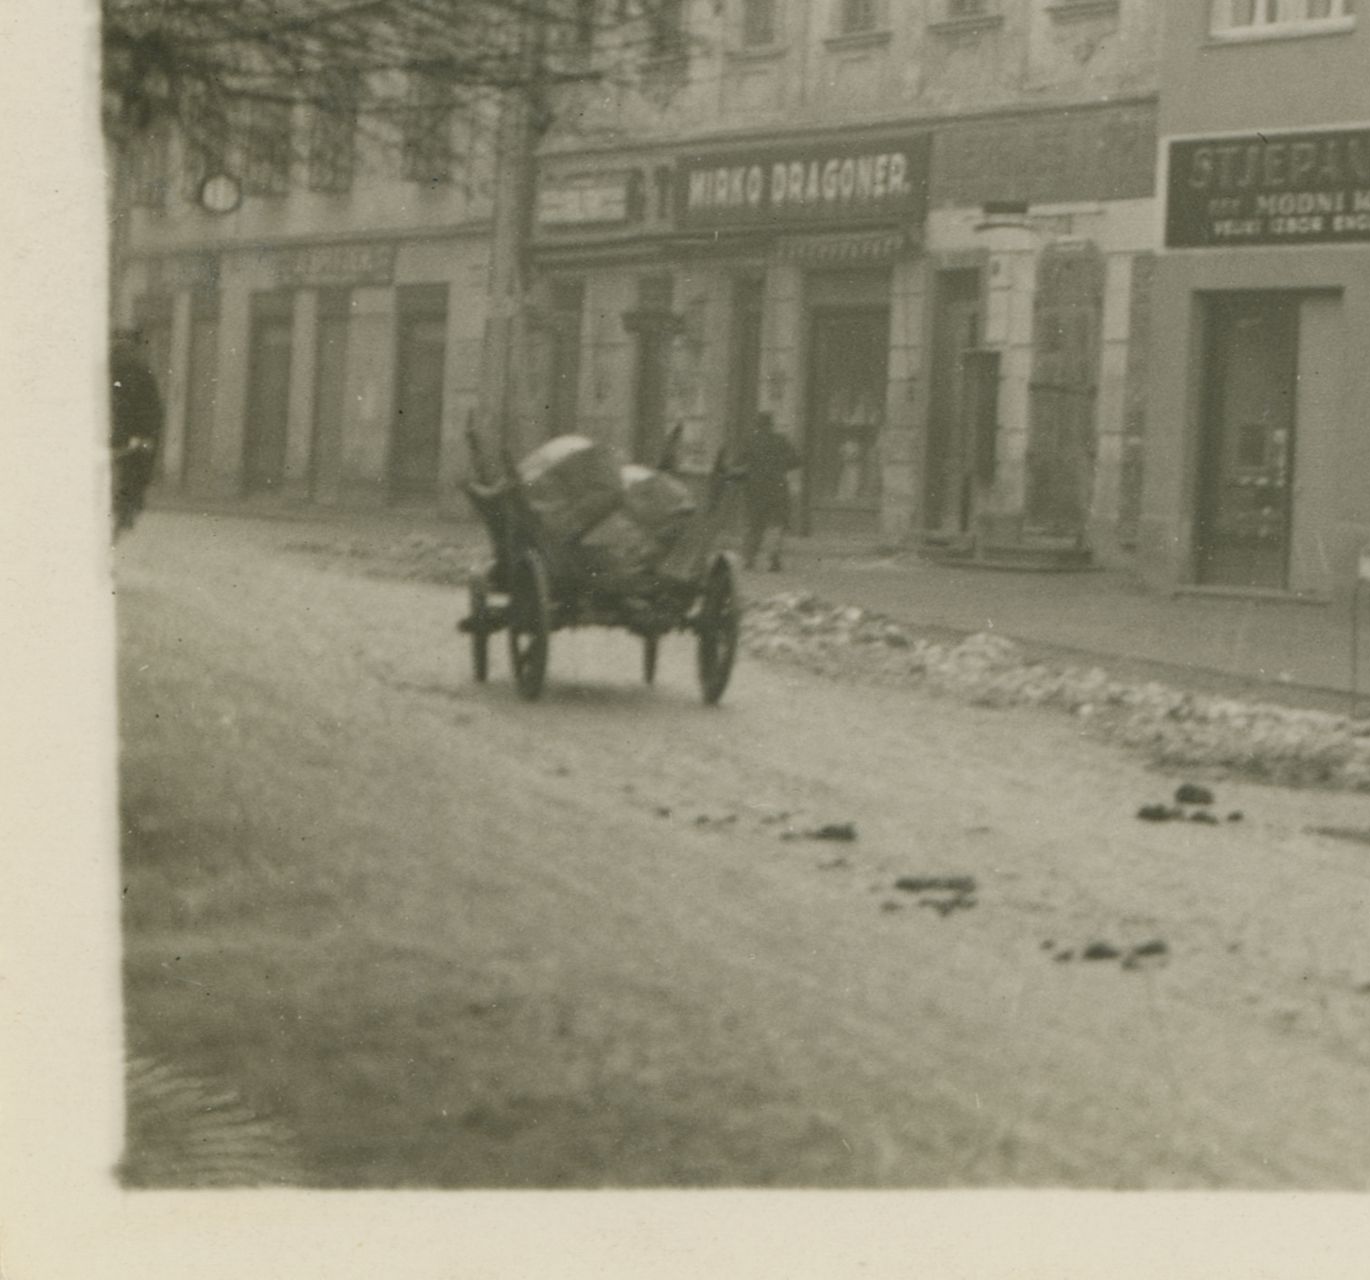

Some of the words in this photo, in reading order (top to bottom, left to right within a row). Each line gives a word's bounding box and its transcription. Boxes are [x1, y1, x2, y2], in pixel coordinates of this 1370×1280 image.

[688, 164, 762, 208] MIRKO
[771, 153, 910, 203] DRAGONER
[1255, 191, 1344, 215] MODNI
